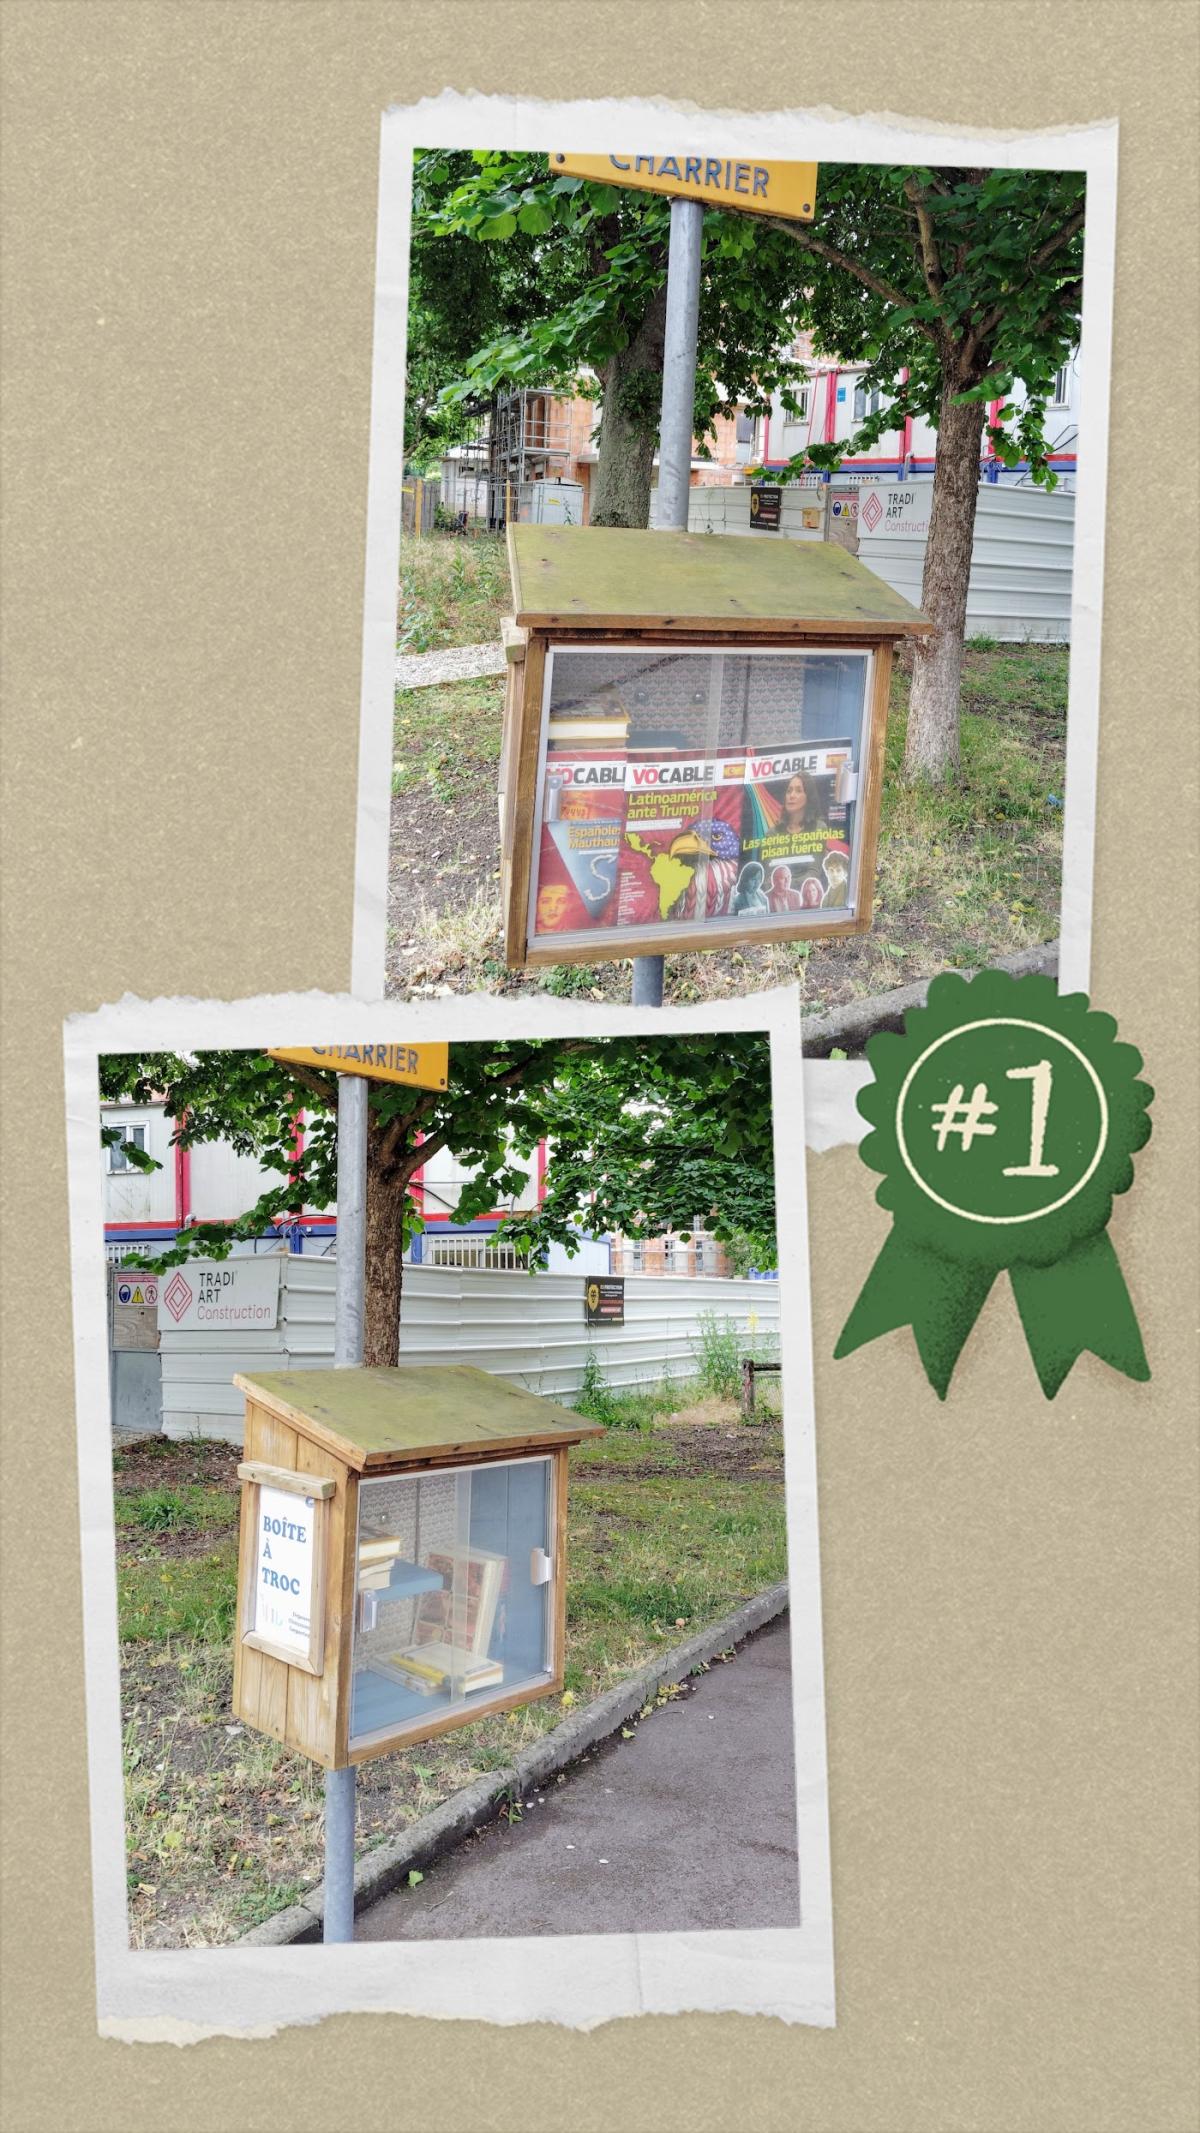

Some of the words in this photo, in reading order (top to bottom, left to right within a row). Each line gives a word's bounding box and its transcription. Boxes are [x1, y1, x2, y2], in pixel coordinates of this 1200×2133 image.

[888, 493, 915, 505] TRADI
[885, 506, 904, 519] ART
[884, 519, 929, 532] Constructi
[752, 755, 818, 777] VOCABLE
[546, 767, 626, 785] OCABL
[633, 766, 714, 785] VOCABLE
[628, 788, 718, 806] Latinoamérica
[627, 806, 658, 819] ante
[659, 804, 700, 818] Trump
[569, 838, 620, 850] Mauthau
[742, 839, 761, 852] Las
[761, 833, 791, 847] series
[791, 828, 845, 843] españolas
[761, 845, 790, 861] pisan
[790, 841, 824, 855] fuerte
[199, 1271, 235, 1287] TRADI
[198, 1288, 221, 1304] ART
[197, 1304, 271, 1320] Construction
[263, 1515, 307, 1544] BOÎTE
[262, 1537, 273, 1560] À
[261, 1567, 300, 1596] TROC
